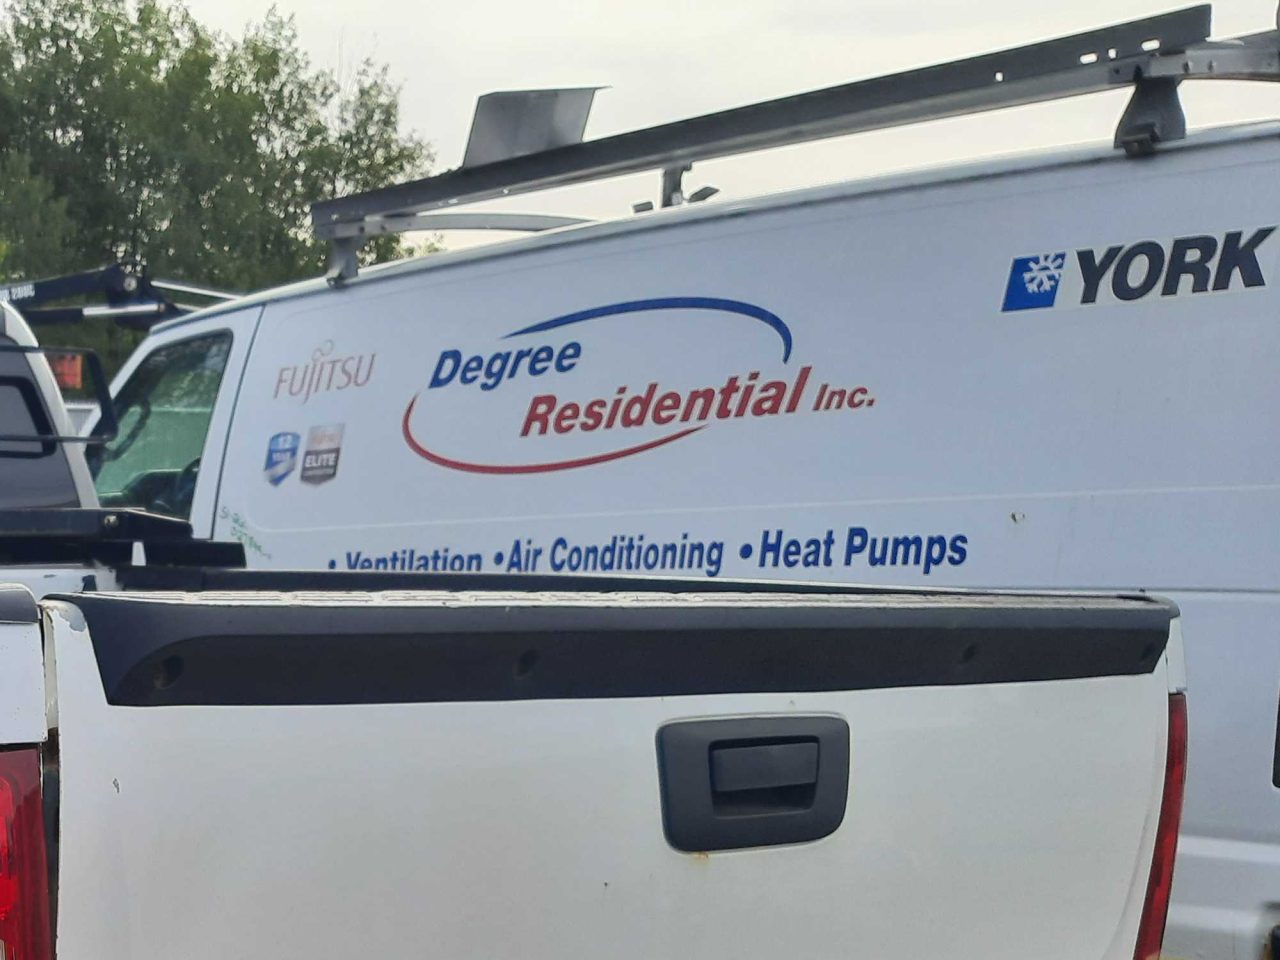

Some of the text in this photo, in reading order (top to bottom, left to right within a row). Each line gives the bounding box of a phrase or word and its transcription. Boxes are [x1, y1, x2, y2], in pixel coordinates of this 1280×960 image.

[1076, 225, 1278, 305] YORK
[273, 348, 377, 405] FUJITSU
[428, 341, 583, 392] Degree
[519, 365, 876, 438] Residential Inc.
[304, 452, 337, 468] ELITE
[345, 526, 969, 577] Ventilation Air Conditioning Heat Pumps
